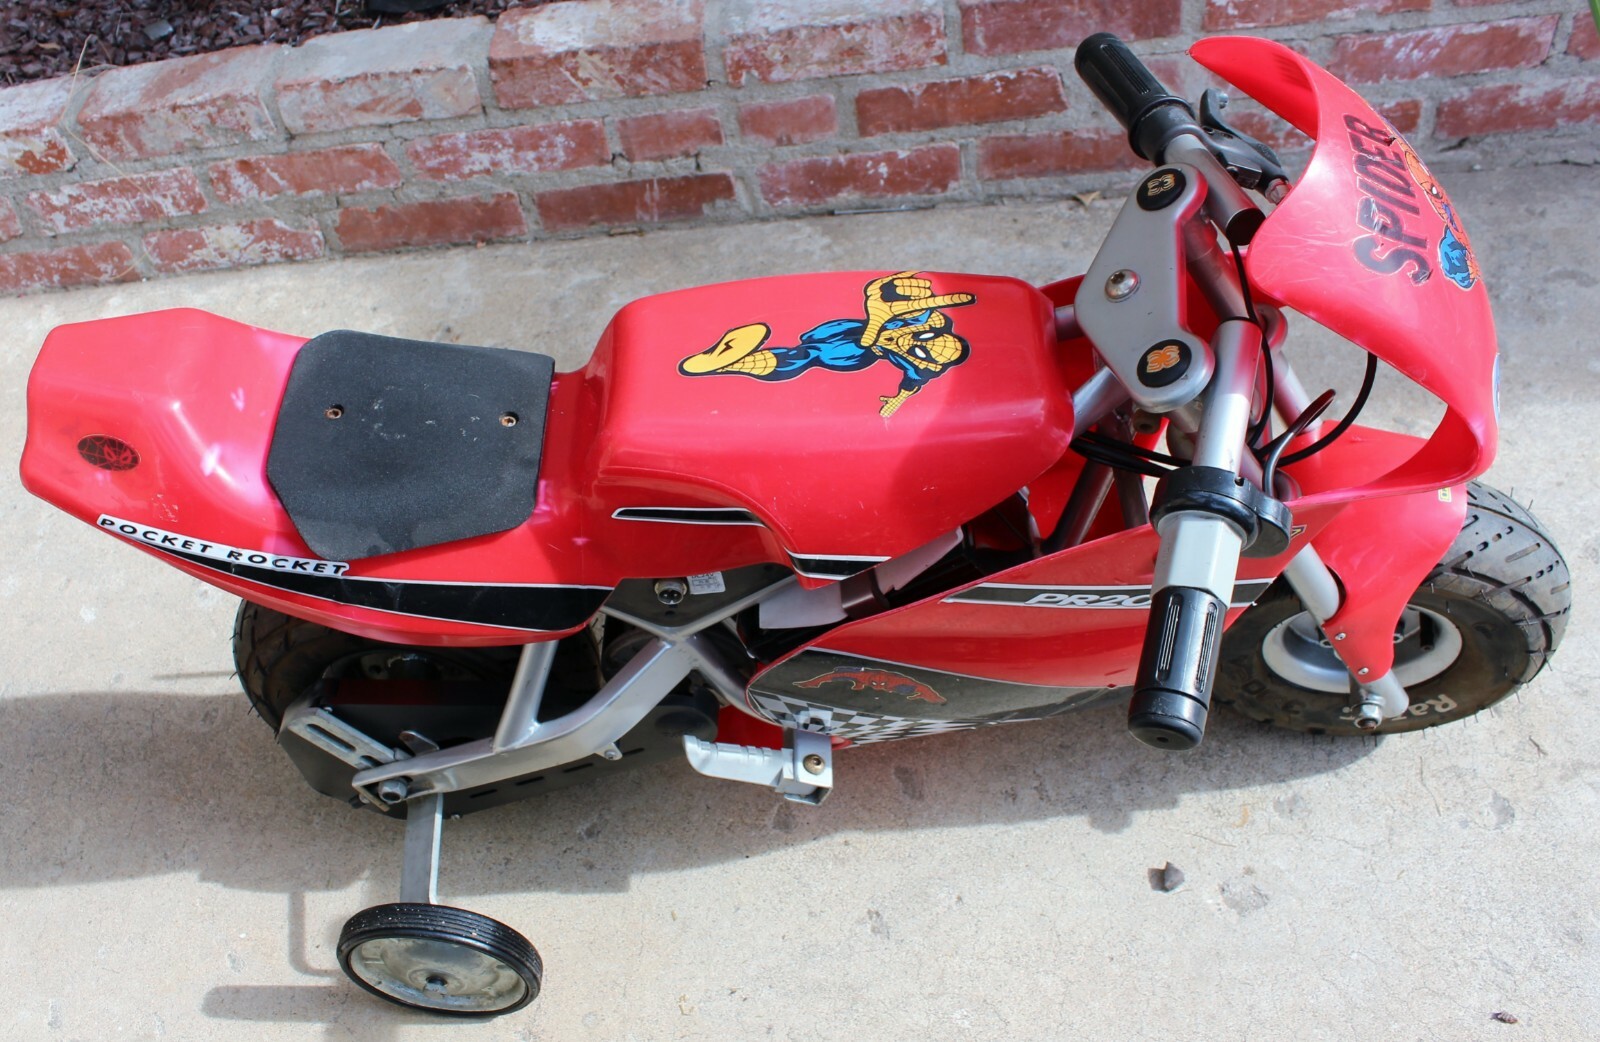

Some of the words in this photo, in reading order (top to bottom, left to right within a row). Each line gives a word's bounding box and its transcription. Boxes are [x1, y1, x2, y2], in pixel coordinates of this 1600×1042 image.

[1343, 114, 1431, 284] SPIDER
[100, 517, 212, 553] POCKET
[227, 549, 346, 575] ROCKET
